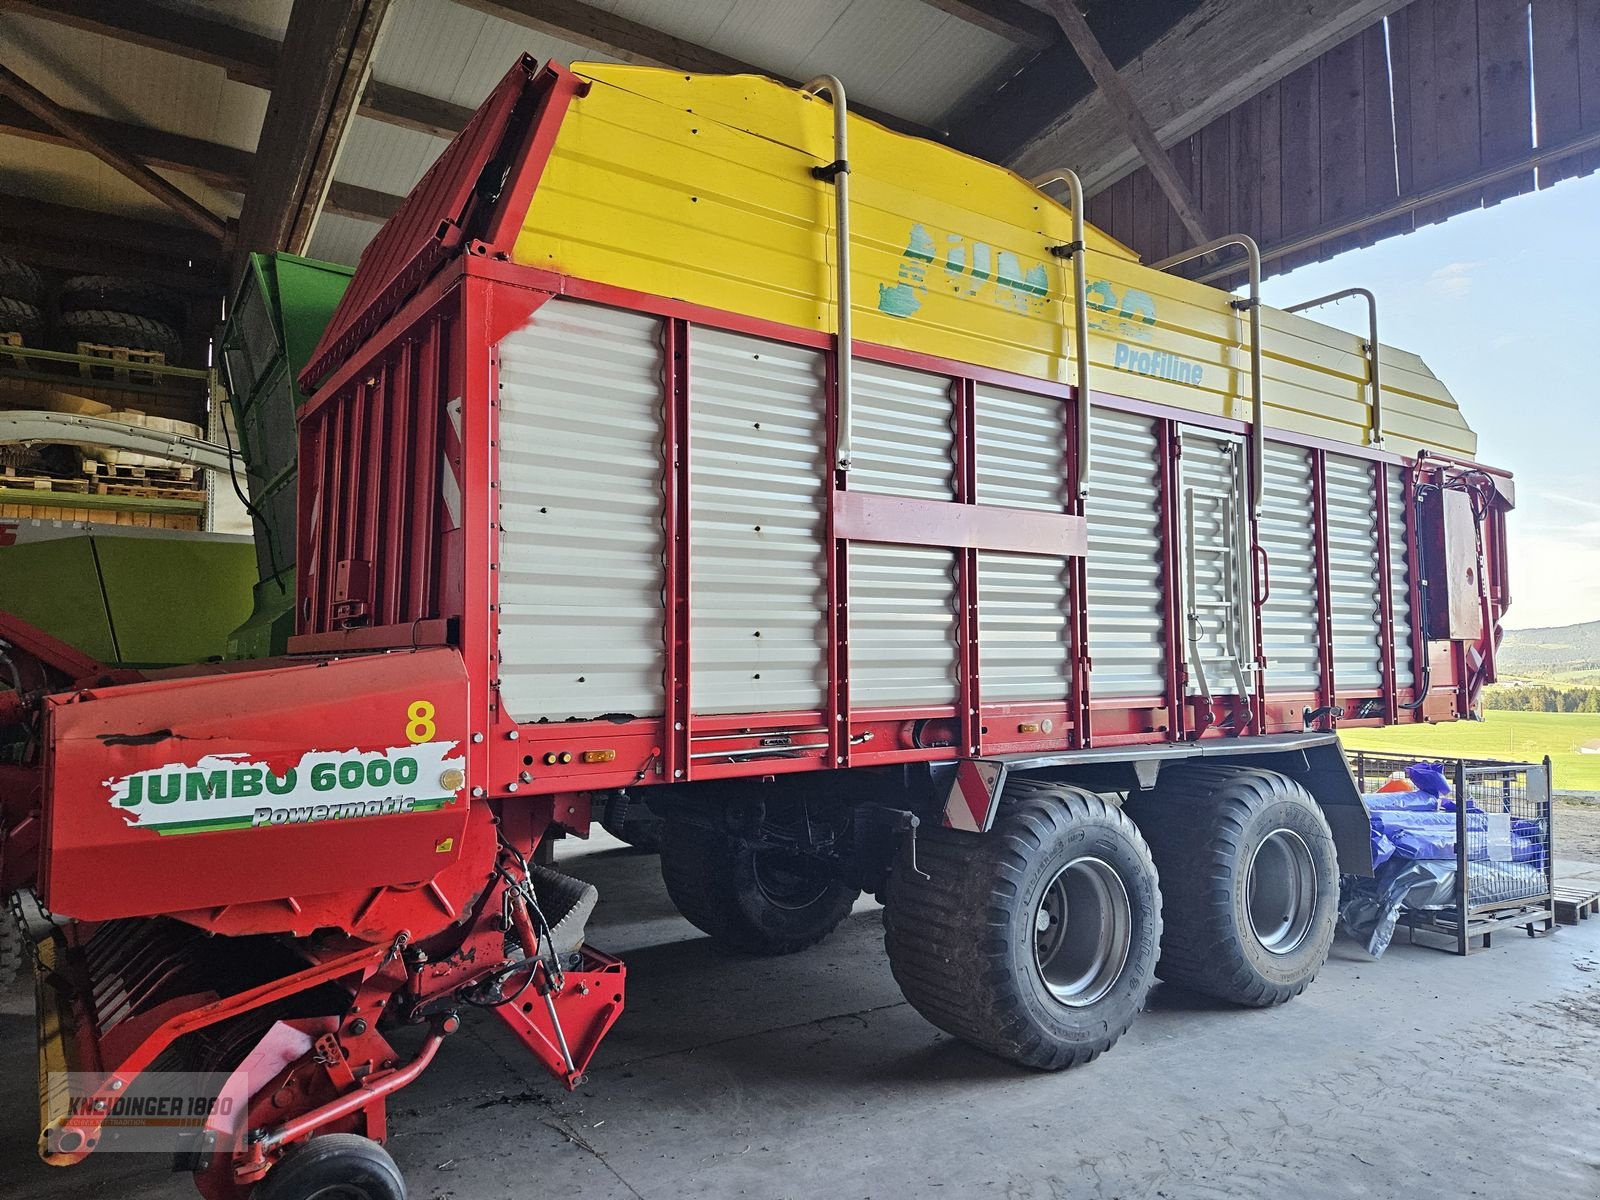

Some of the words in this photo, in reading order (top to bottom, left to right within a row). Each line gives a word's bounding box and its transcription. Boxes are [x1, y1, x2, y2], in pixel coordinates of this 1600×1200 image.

[1113, 342, 1203, 388] Profiline
[405, 700, 436, 743] 8
[119, 767, 298, 807] JUMBO
[309, 757, 419, 792] 6000
[251, 794, 416, 828] Powermatic
